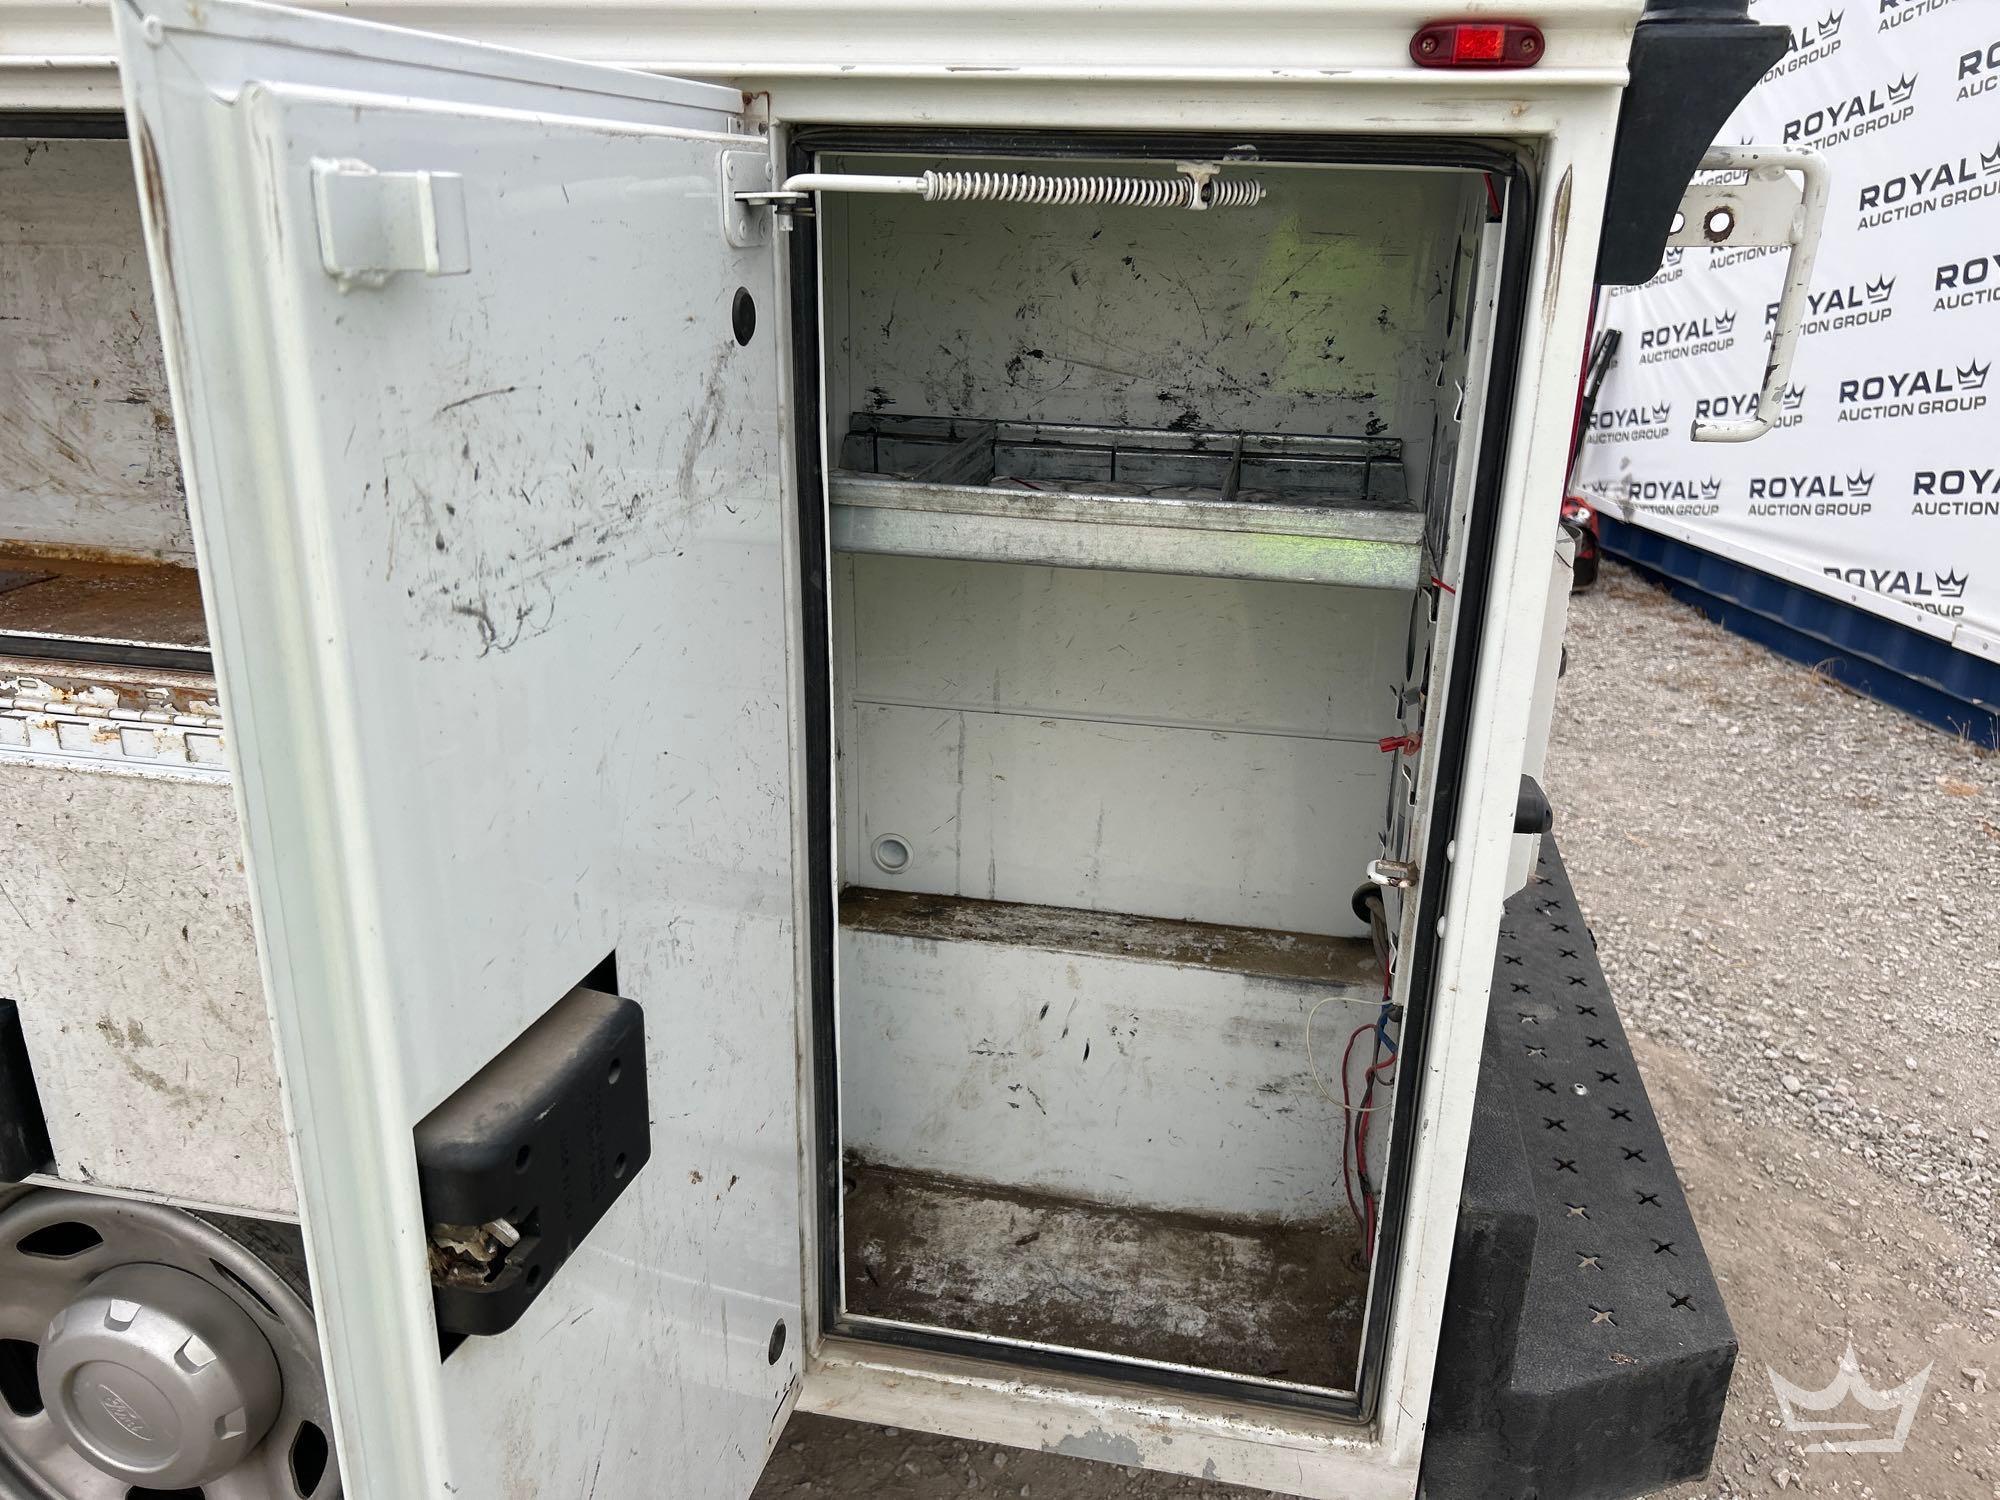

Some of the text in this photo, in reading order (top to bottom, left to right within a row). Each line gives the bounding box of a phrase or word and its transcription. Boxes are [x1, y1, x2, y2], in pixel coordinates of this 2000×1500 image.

[1788, 40, 1842, 73] GROUP
[1783, 90, 1885, 145] ROYAL
[1812, 105, 1914, 150] TION GROUP
[1859, 158, 1977, 212] ROYAL
[1857, 179, 2000, 231] AUCTION GROU
[1709, 245, 1766, 271] AUCTION
[1765, 286, 1863, 325] RYAL
[1933, 286, 2000, 312] AUCTIO
[1833, 307, 1892, 330] GROUP
[1640, 318, 1713, 349] ROYAL
[1639, 346, 1689, 364] AUCTION
[1691, 337, 1734, 356] GROUP
[1838, 368, 1953, 403] ROYAL
[1696, 393, 1760, 418] ROYA
[1838, 395, 1987, 422] AUCTION GROUP
[1631, 427, 1669, 441] GROUP
[1629, 481, 1699, 499] ROYAL
[1748, 475, 1844, 498] ROYAL
[1913, 468, 2000, 495] ROY
[1676, 503, 1719, 516] GROUP
[1748, 502, 1872, 516] AUCTION GROUP
[1911, 501, 1999, 515] AUCTION
